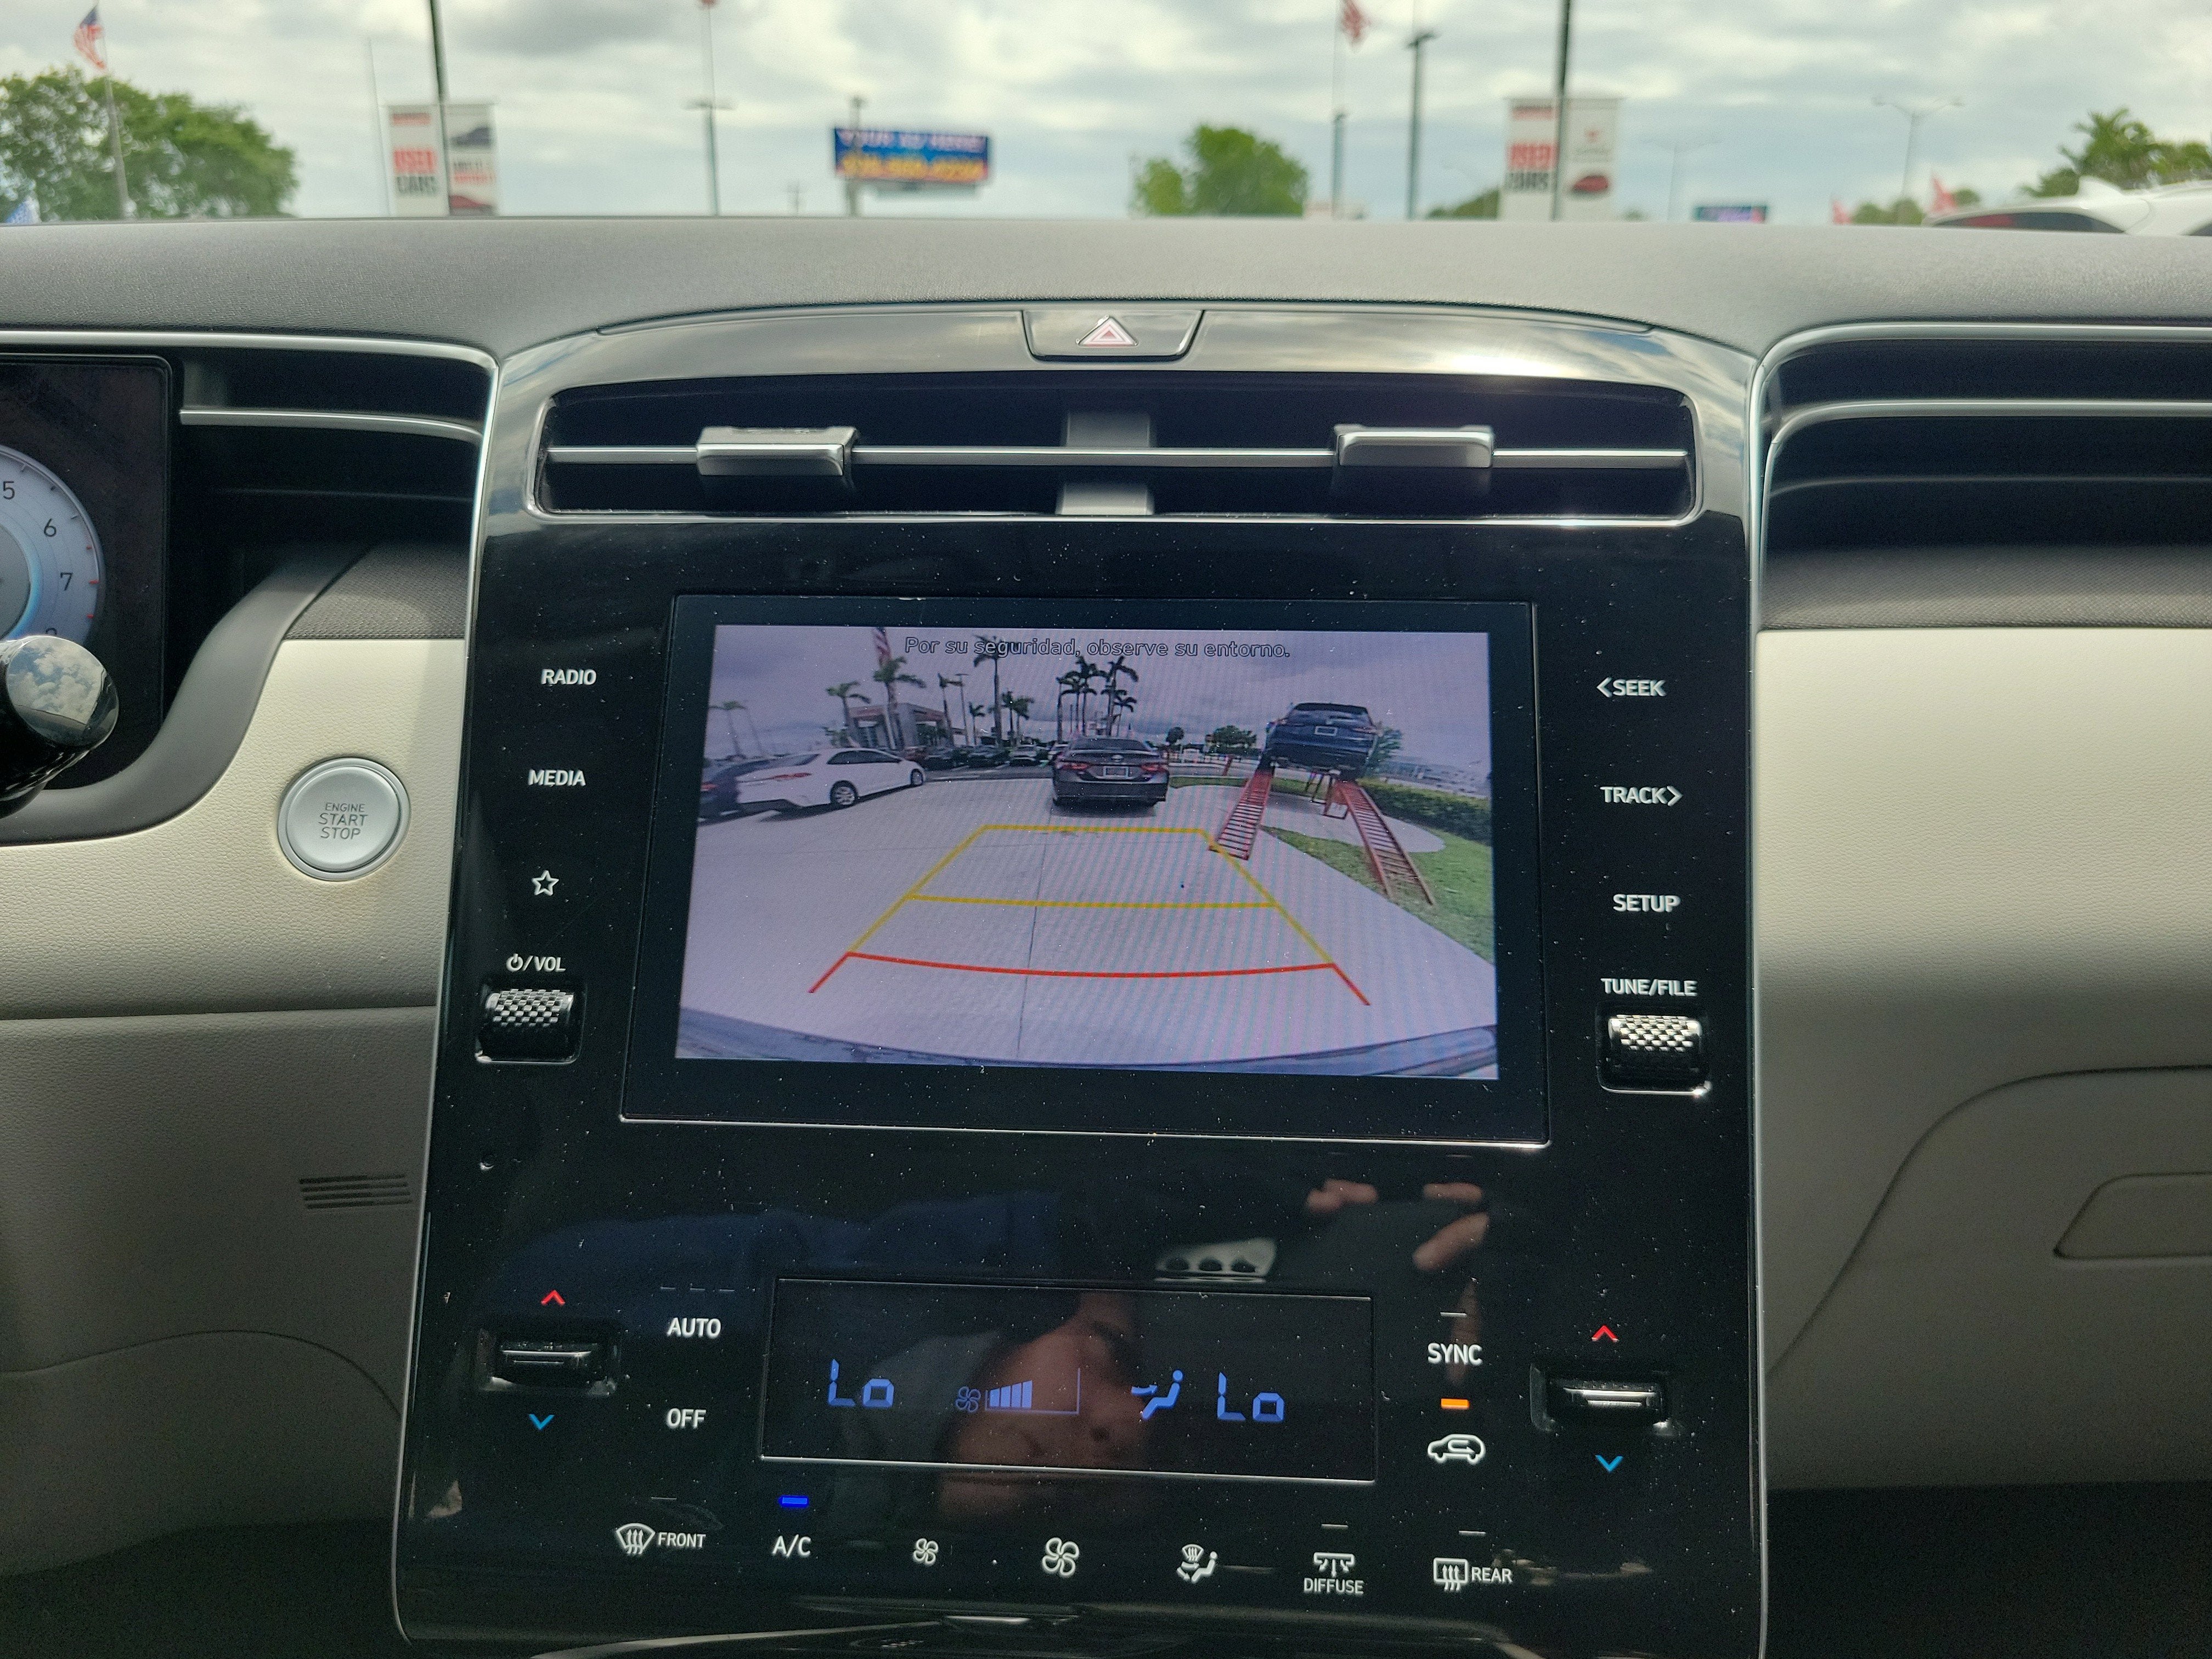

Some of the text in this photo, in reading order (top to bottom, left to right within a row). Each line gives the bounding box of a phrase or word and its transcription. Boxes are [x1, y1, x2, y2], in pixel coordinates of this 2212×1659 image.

[3, 481, 15, 500] 5
[44, 518, 57, 537] 6
[60, 572, 73, 590] 7
[905, 636, 1290, 657] Por su seguridad, observe su entorno.
[541, 668, 597, 685] RADIO
[528, 769, 586, 787] MEDIA
[325, 803, 366, 812] ENGINE
[318, 812, 368, 826] START
[320, 827, 361, 839] STOP
[1613, 894, 1680, 912] SETUP
[1600, 978, 1697, 996] TUNE/FILE
[666, 1318, 721, 1338] AUTO
[1427, 1343, 1482, 1366] SYNC
[666, 1408, 707, 1429] OFF
[658, 1532, 706, 1548] FRONT
[771, 1534, 811, 1558] A/C
[1471, 1567, 1513, 1583] REAR
[1304, 1578, 1364, 1594] DIFFUSE
